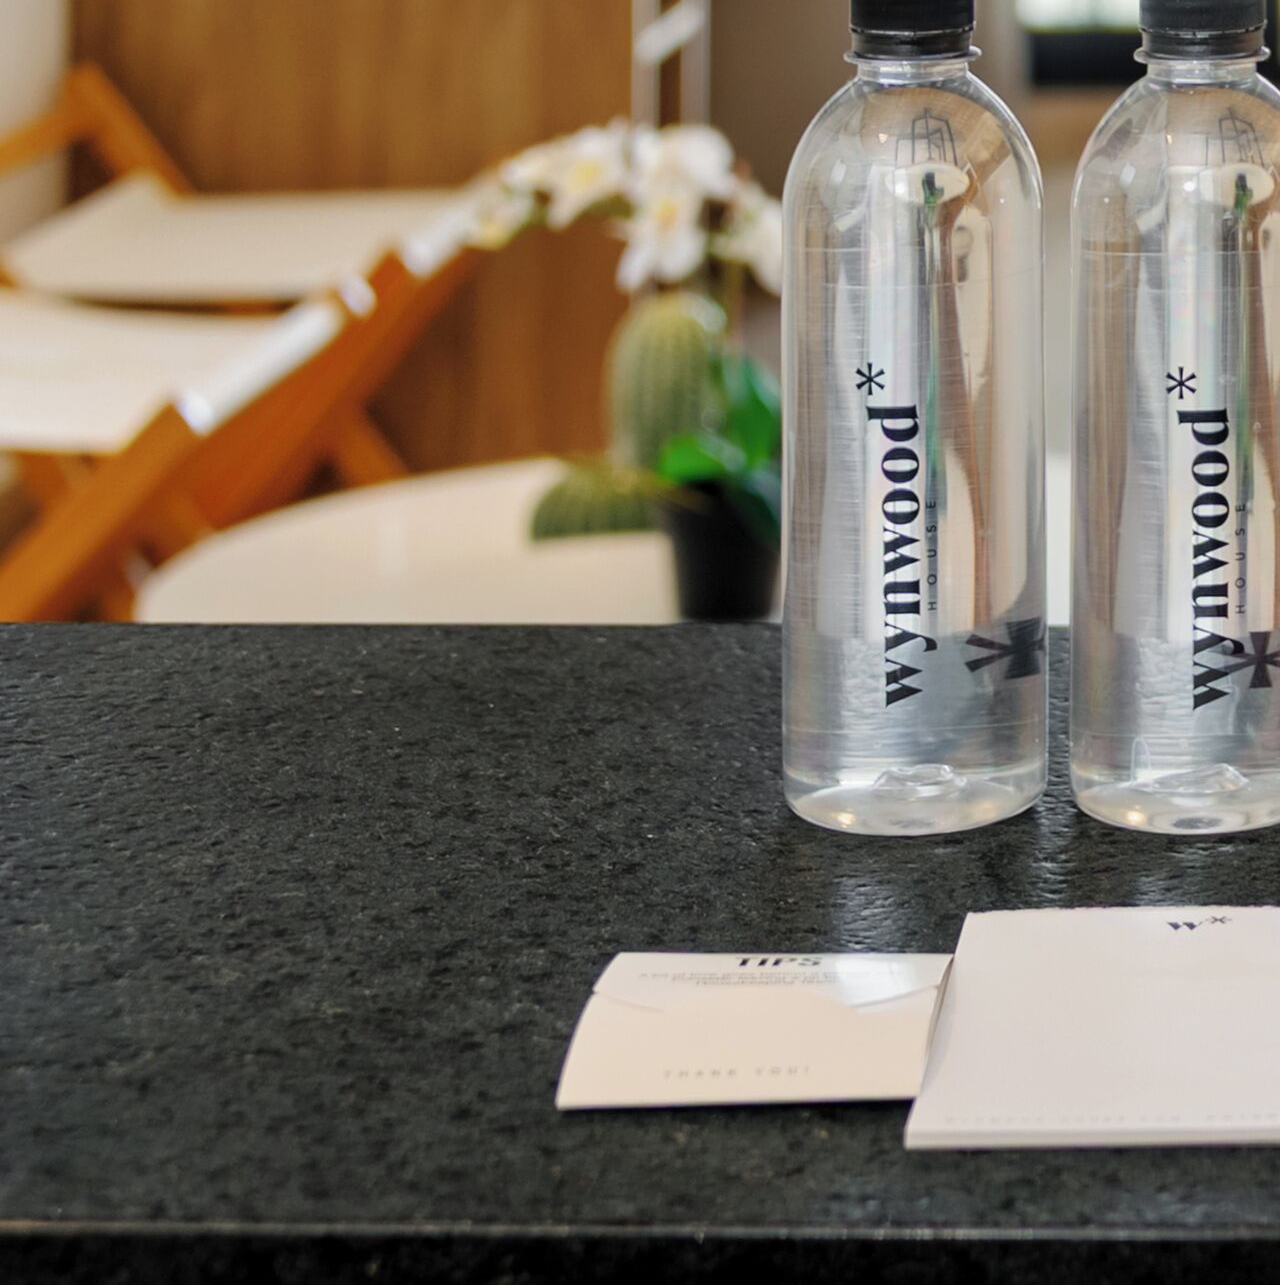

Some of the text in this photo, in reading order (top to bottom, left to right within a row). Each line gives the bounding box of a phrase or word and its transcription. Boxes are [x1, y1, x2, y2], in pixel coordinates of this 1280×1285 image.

[926, 501, 939, 612] HOUSE
[1235, 504, 1247, 615] HOUSE
[737, 957, 824, 967] TIPS
